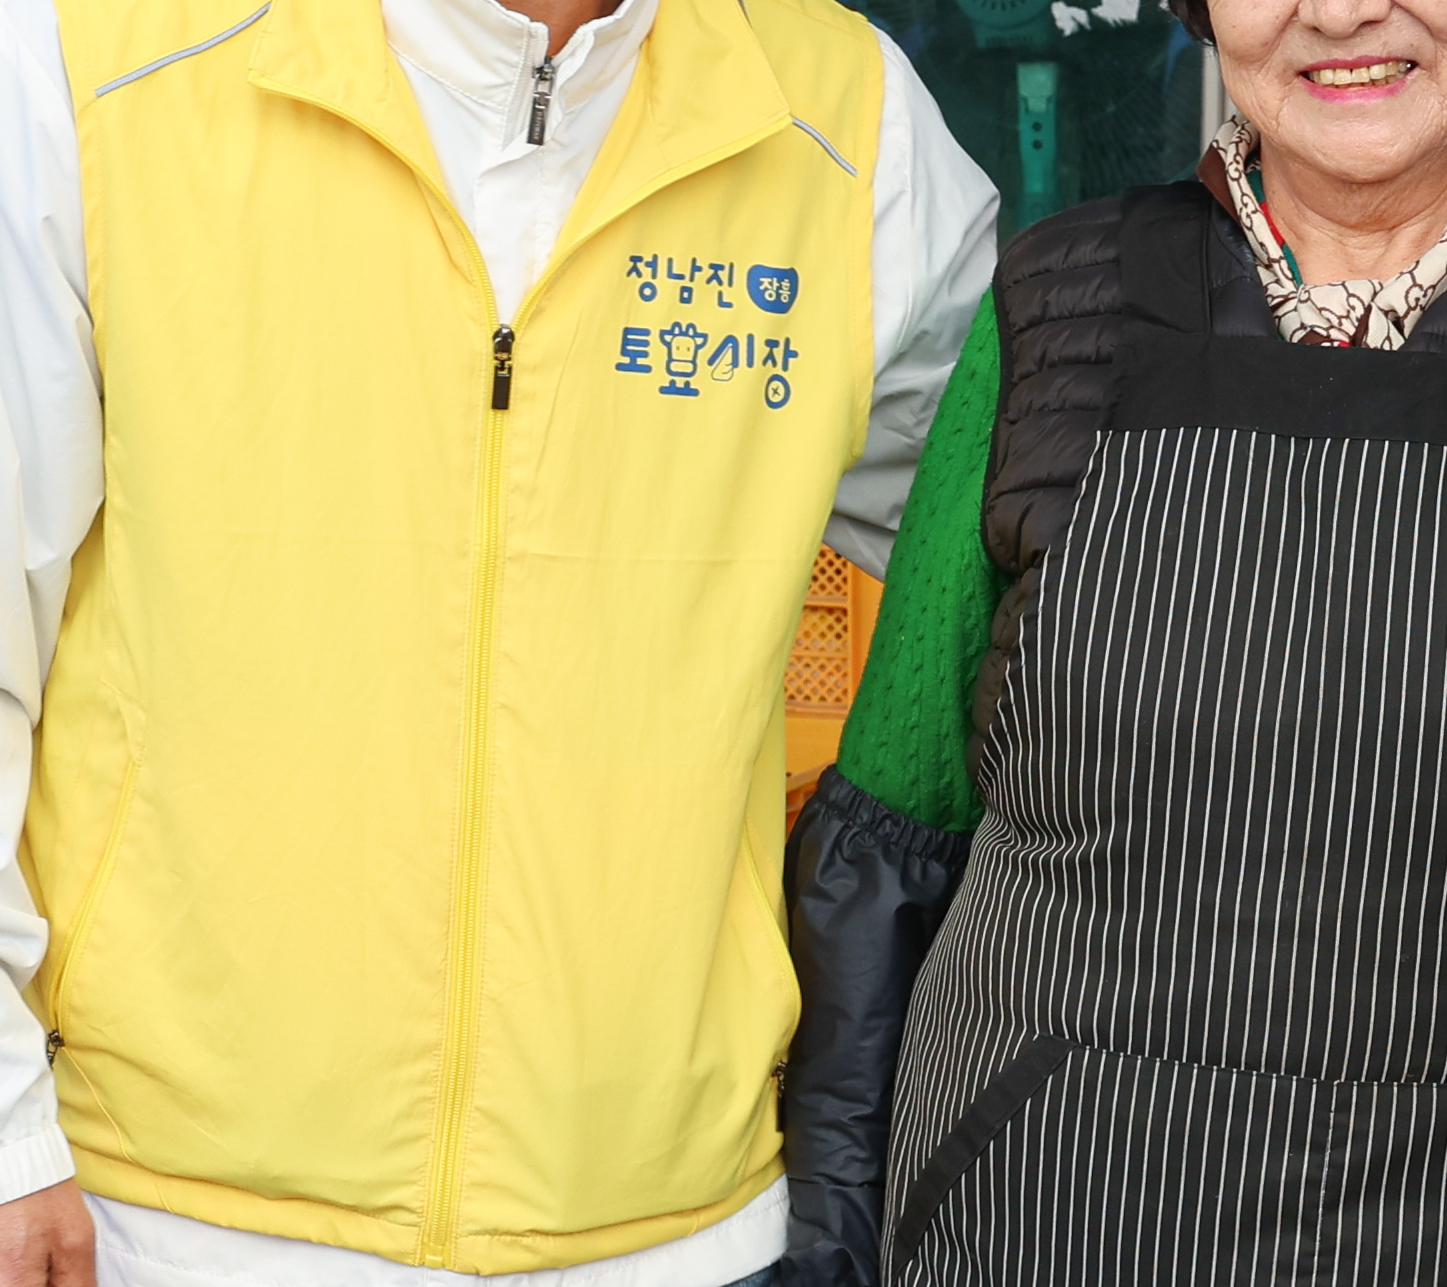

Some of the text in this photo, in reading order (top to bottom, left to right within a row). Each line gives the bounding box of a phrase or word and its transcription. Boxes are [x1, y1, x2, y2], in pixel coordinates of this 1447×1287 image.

[626, 253, 791, 308] 정남진 장흥
[615, 321, 799, 410] 토요시장
